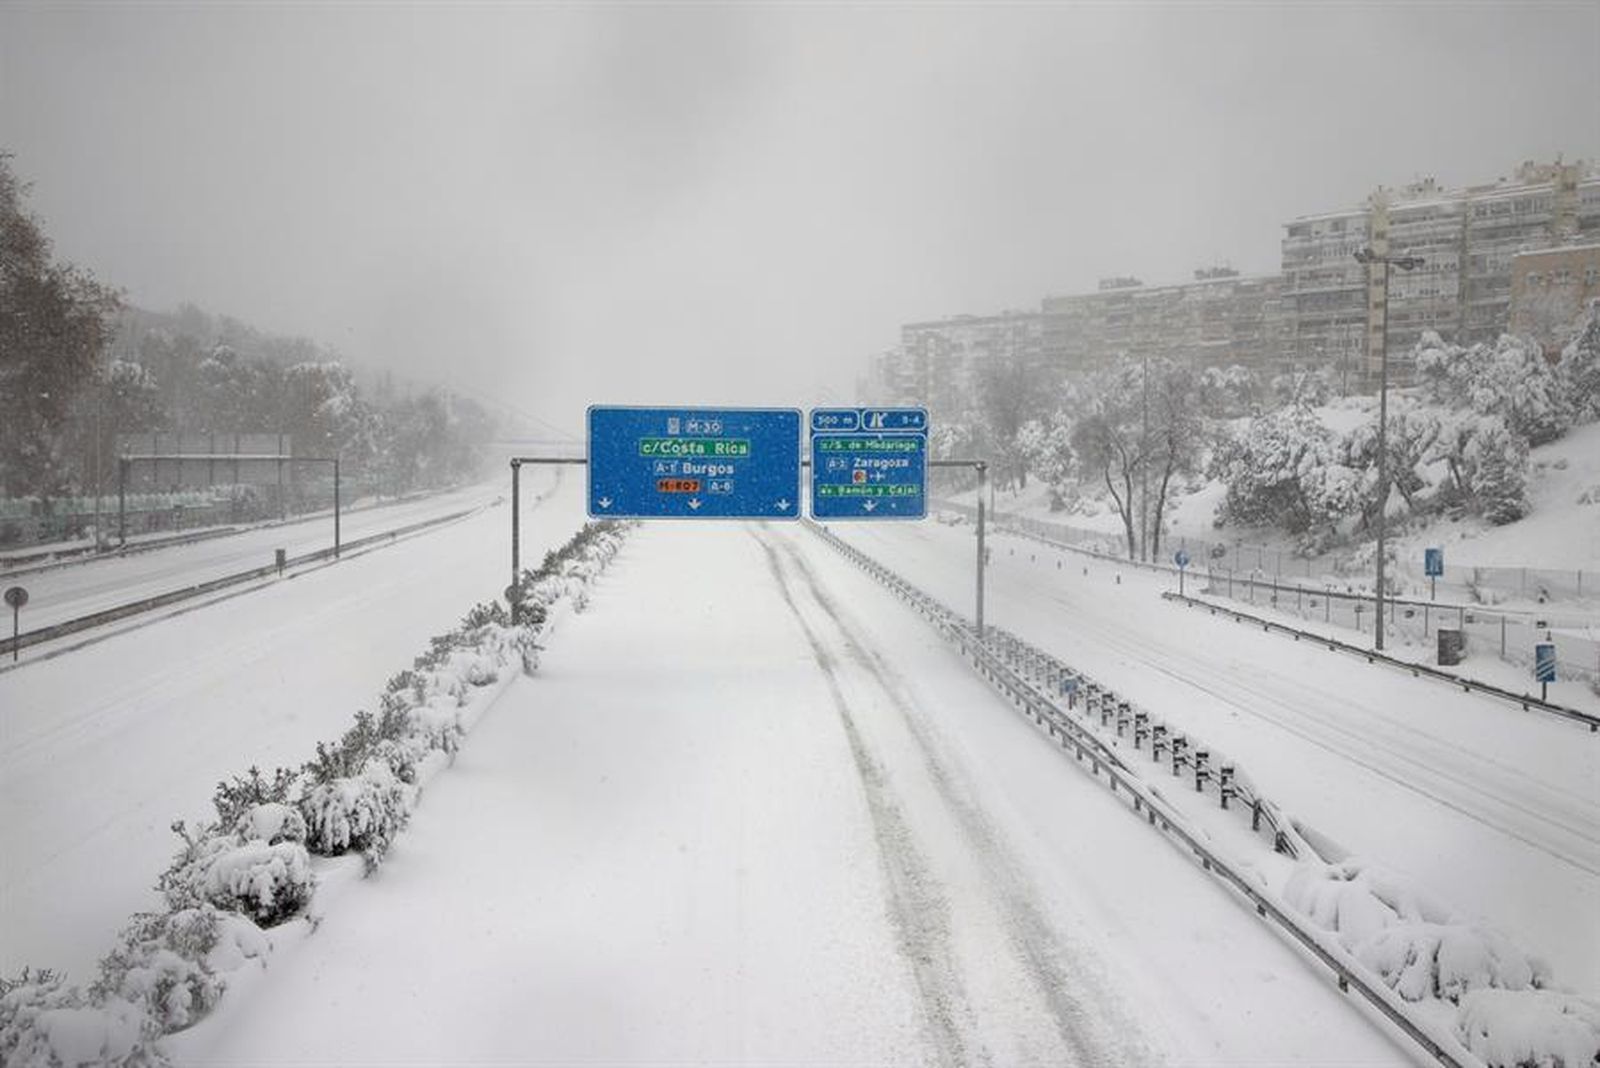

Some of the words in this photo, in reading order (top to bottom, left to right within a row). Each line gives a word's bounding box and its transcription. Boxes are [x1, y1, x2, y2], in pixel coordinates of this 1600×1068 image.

[687, 419, 721, 433] M-30
[642, 440, 704, 454] c/Costa
[715, 440, 747, 454] Rica
[849, 441, 861, 450] de
[683, 463, 734, 477] Burgos
[853, 458, 909, 470] Zaragoza
